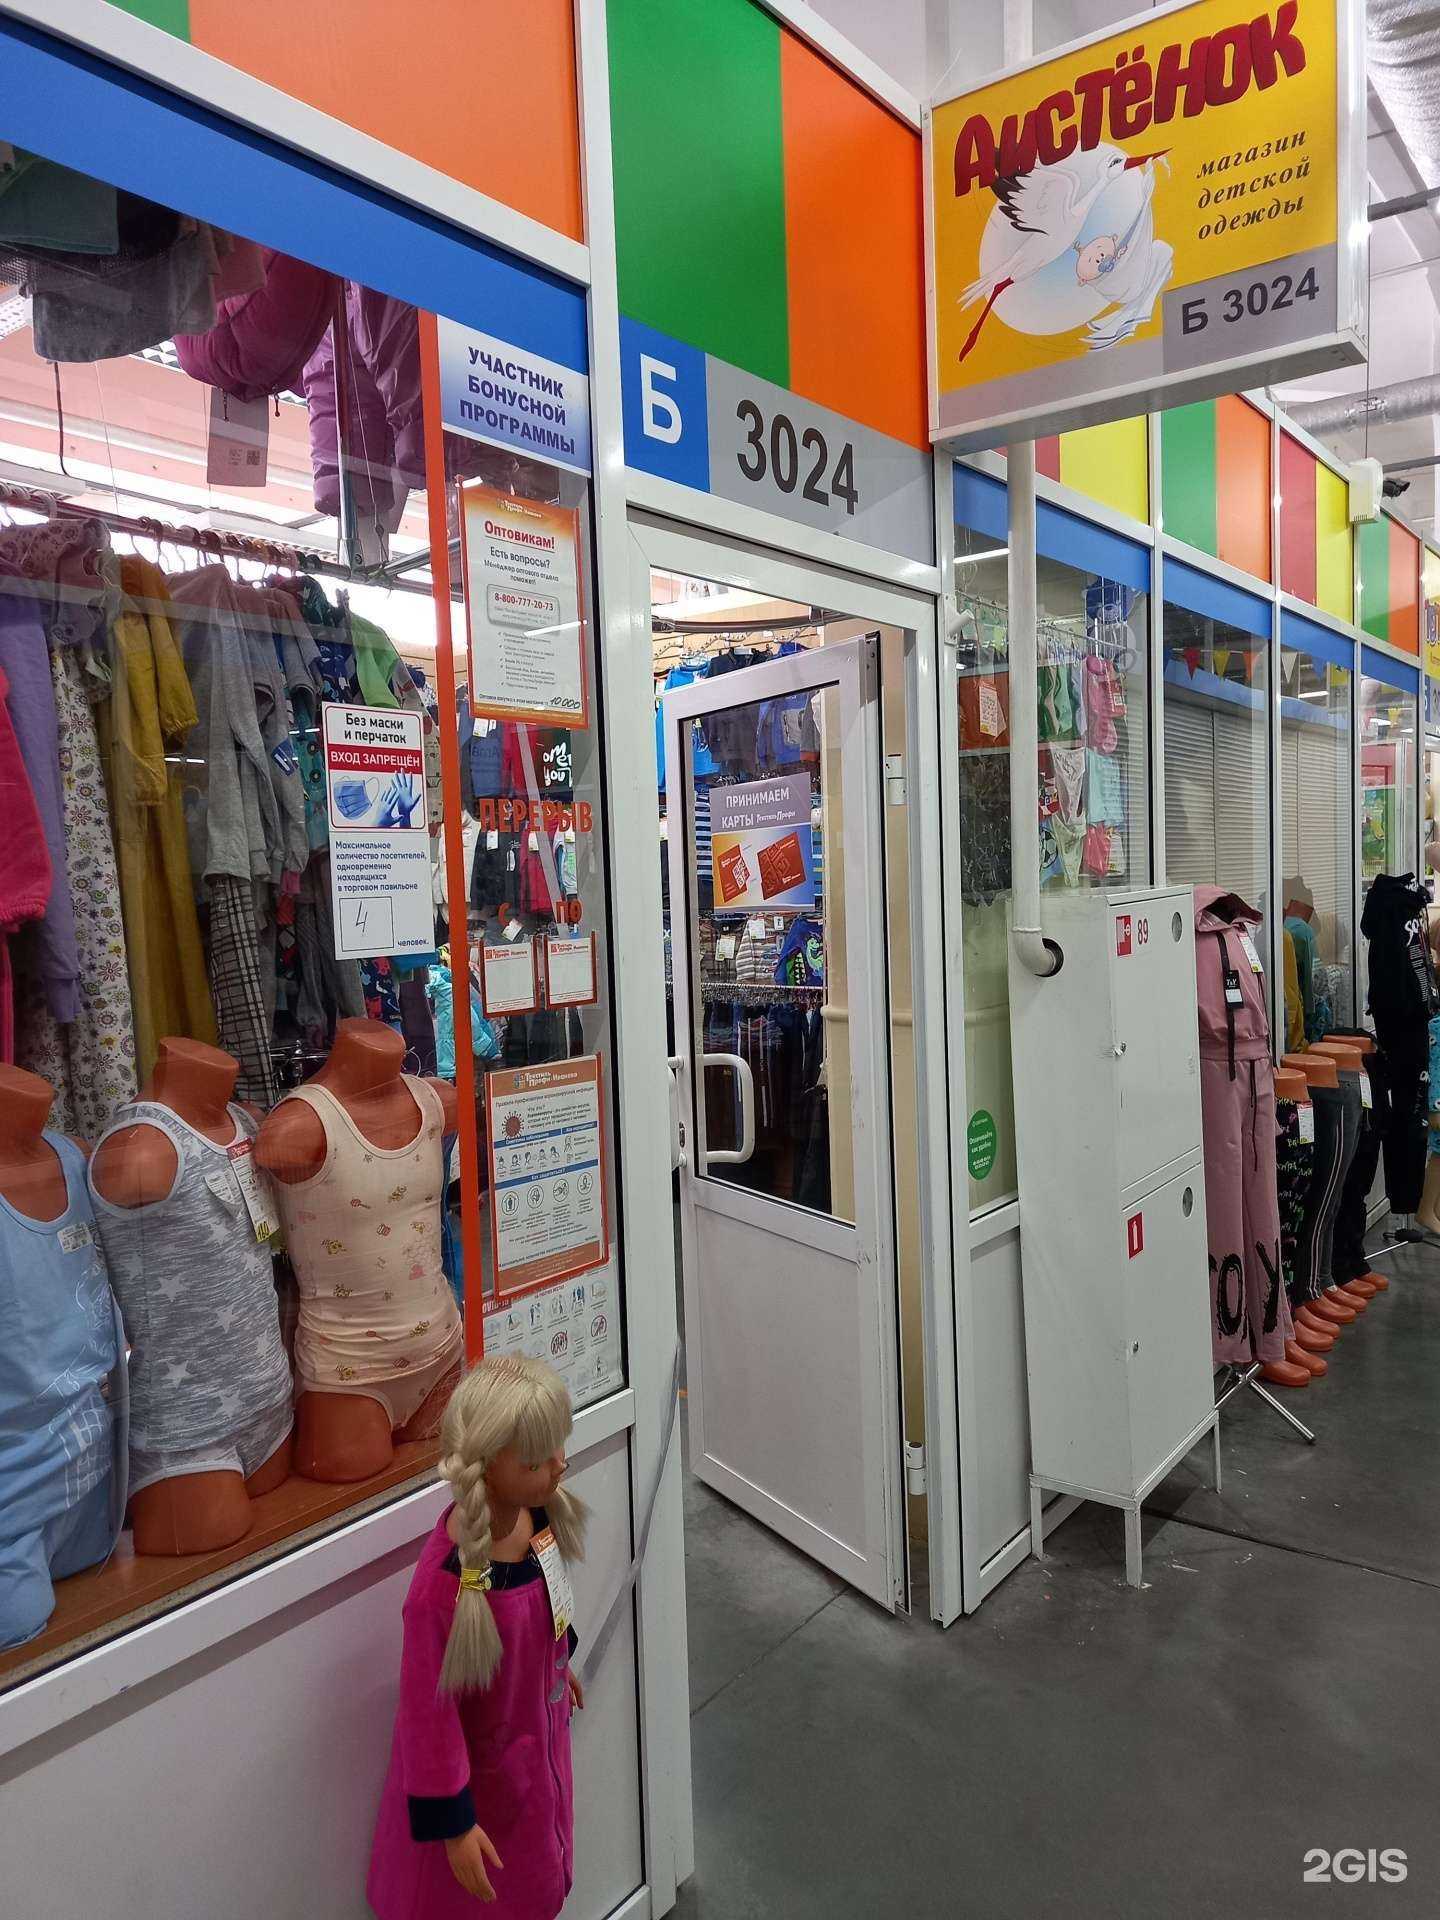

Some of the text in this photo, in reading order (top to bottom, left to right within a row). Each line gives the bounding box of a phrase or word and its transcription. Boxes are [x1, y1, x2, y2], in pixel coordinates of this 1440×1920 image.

[1196, 130, 1306, 179] магазин
[1197, 156, 1311, 210] детской
[1198, 195, 1304, 240] одежды
[1182, 267, 1320, 336] Б 3024
[468, 345, 564, 399] УЧАСТНИК
[468, 375, 567, 426] БОНУСНОЙ
[460, 399, 576, 456] ПРОГРАММЫ
[640, 353, 859, 516] Б 3024
[484, 520, 555, 549] Оптовикам!
[490, 546, 551, 569] Есть вопросы?
[494, 592, 554, 611] 8-800-777-20-73
[345, 712, 404, 730] Без маски
[344, 730, 407, 745] и перчаток
[330, 751, 420, 768] ВХОД ЗАПРЕЩЁН
[725, 786, 790, 809] ПРИНИМАЕМ
[480, 798, 593, 833] ПЕРЕРЫВ
[721, 813, 754, 830] КАРТЫ
[335, 840, 392, 850] Максимальное
[336, 852, 379, 861] количество
[336, 862, 392, 872] одновременно
[337, 872, 387, 882] находящихся
[344, 884, 379, 893] торговом
[380, 882, 419, 891] павильоне
[355, 900, 368, 933] 4
[397, 938, 430, 947] человек.
[1137, 918, 1149, 945] 89
